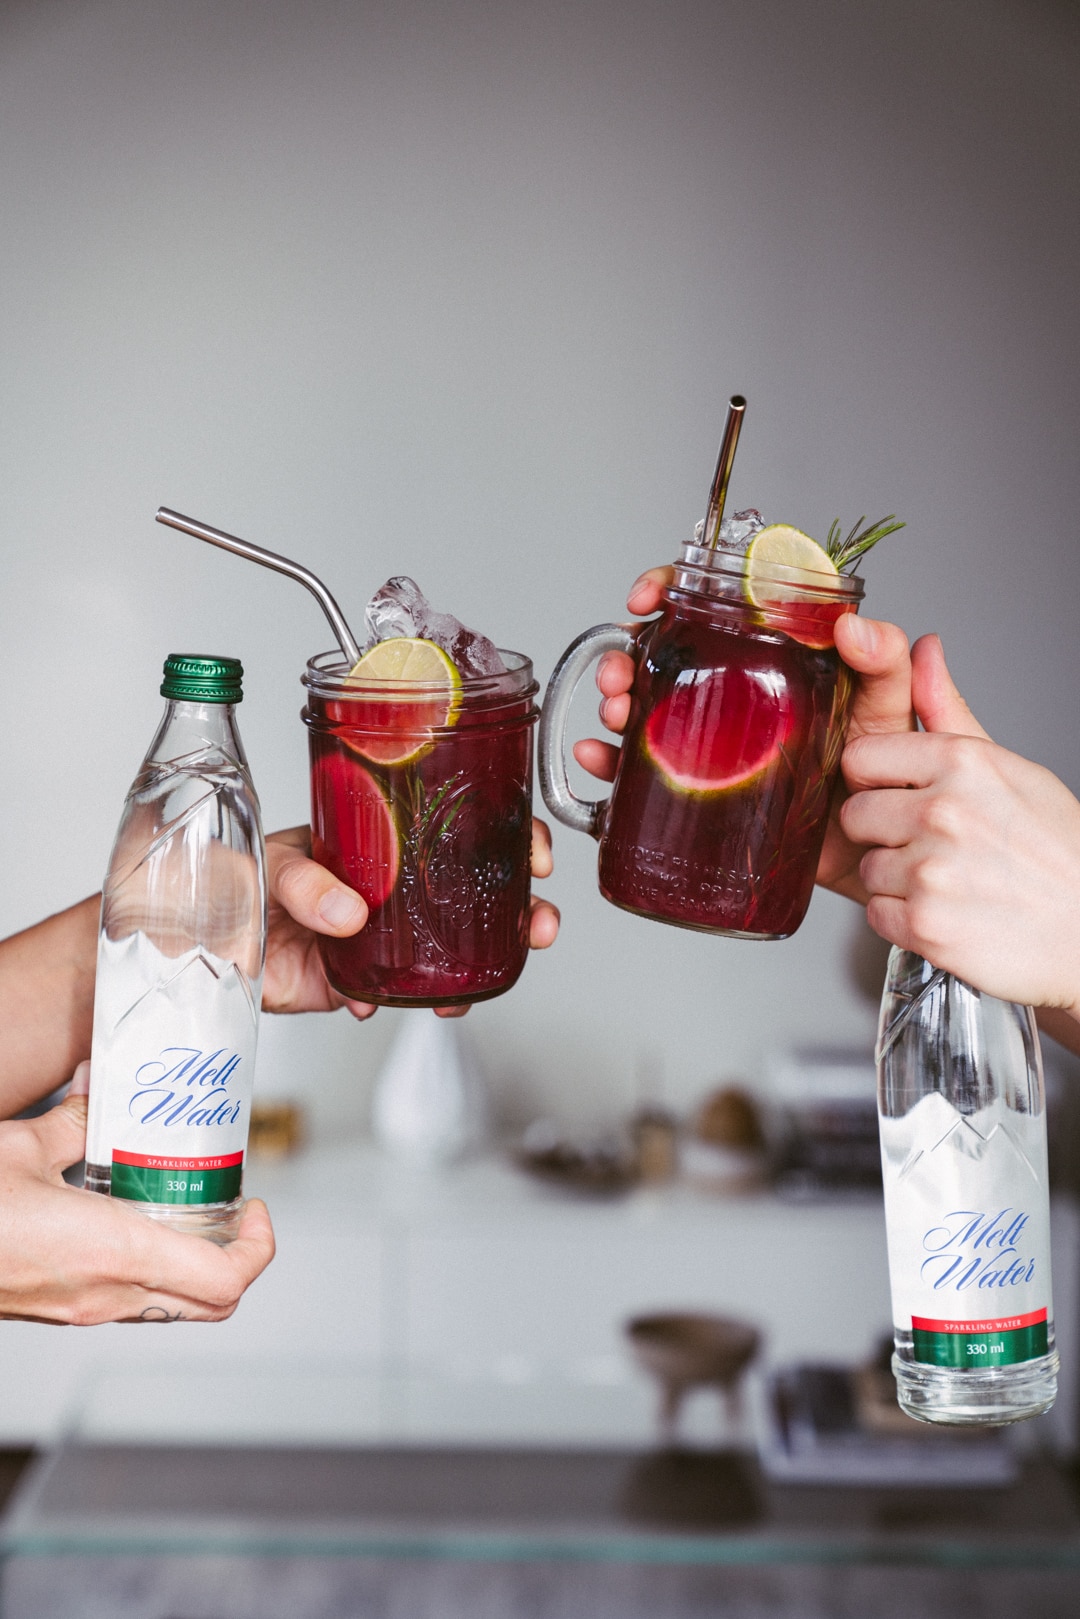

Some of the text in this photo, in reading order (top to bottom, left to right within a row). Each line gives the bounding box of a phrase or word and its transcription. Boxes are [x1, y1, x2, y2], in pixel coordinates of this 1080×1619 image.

[135, 1047, 242, 1087] Melt
[128, 1087, 242, 1127] Water
[147, 1158, 222, 1168] SPARKLING WATER
[166, 1180, 204, 1192] 330 ml
[922, 1207, 1030, 1252] Melt
[920, 1247, 1035, 1291] Water
[944, 1319, 1021, 1331] SPARKLING WATER
[966, 1342, 1005, 1355] 330 ml
